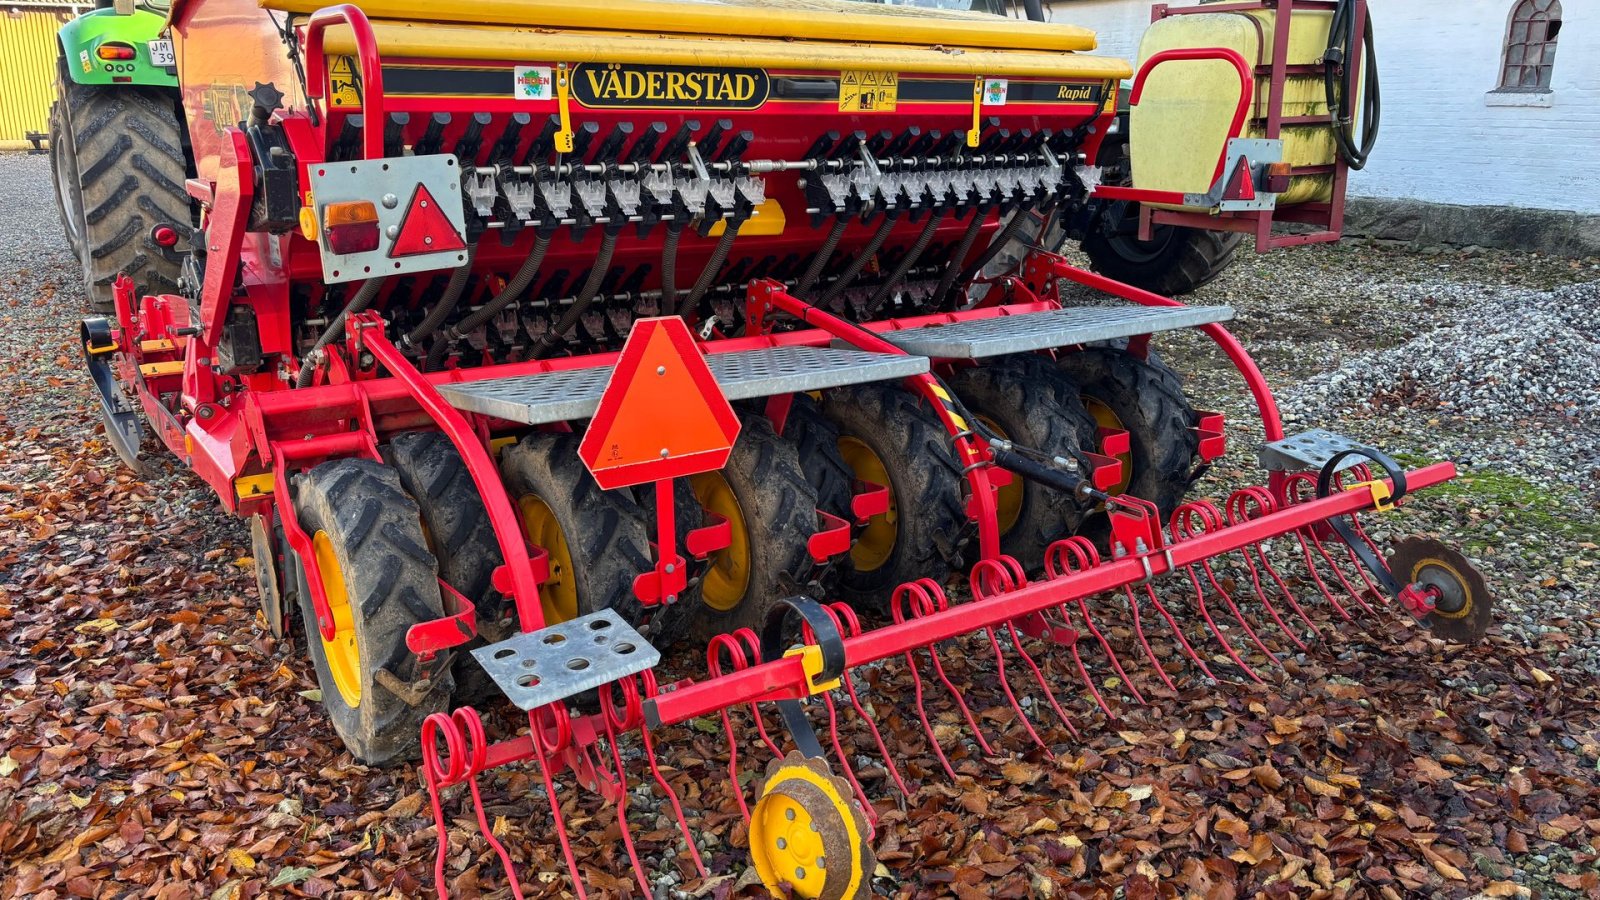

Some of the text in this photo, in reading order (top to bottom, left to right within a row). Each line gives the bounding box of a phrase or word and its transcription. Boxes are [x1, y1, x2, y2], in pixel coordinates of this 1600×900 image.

[152, 42, 168, 51] JM
[159, 53, 173, 63] 39
[517, 76, 550, 84] HEDEN
[585, 63, 756, 101] VÄDERSTAD
[1057, 85, 1092, 101] Rapid
